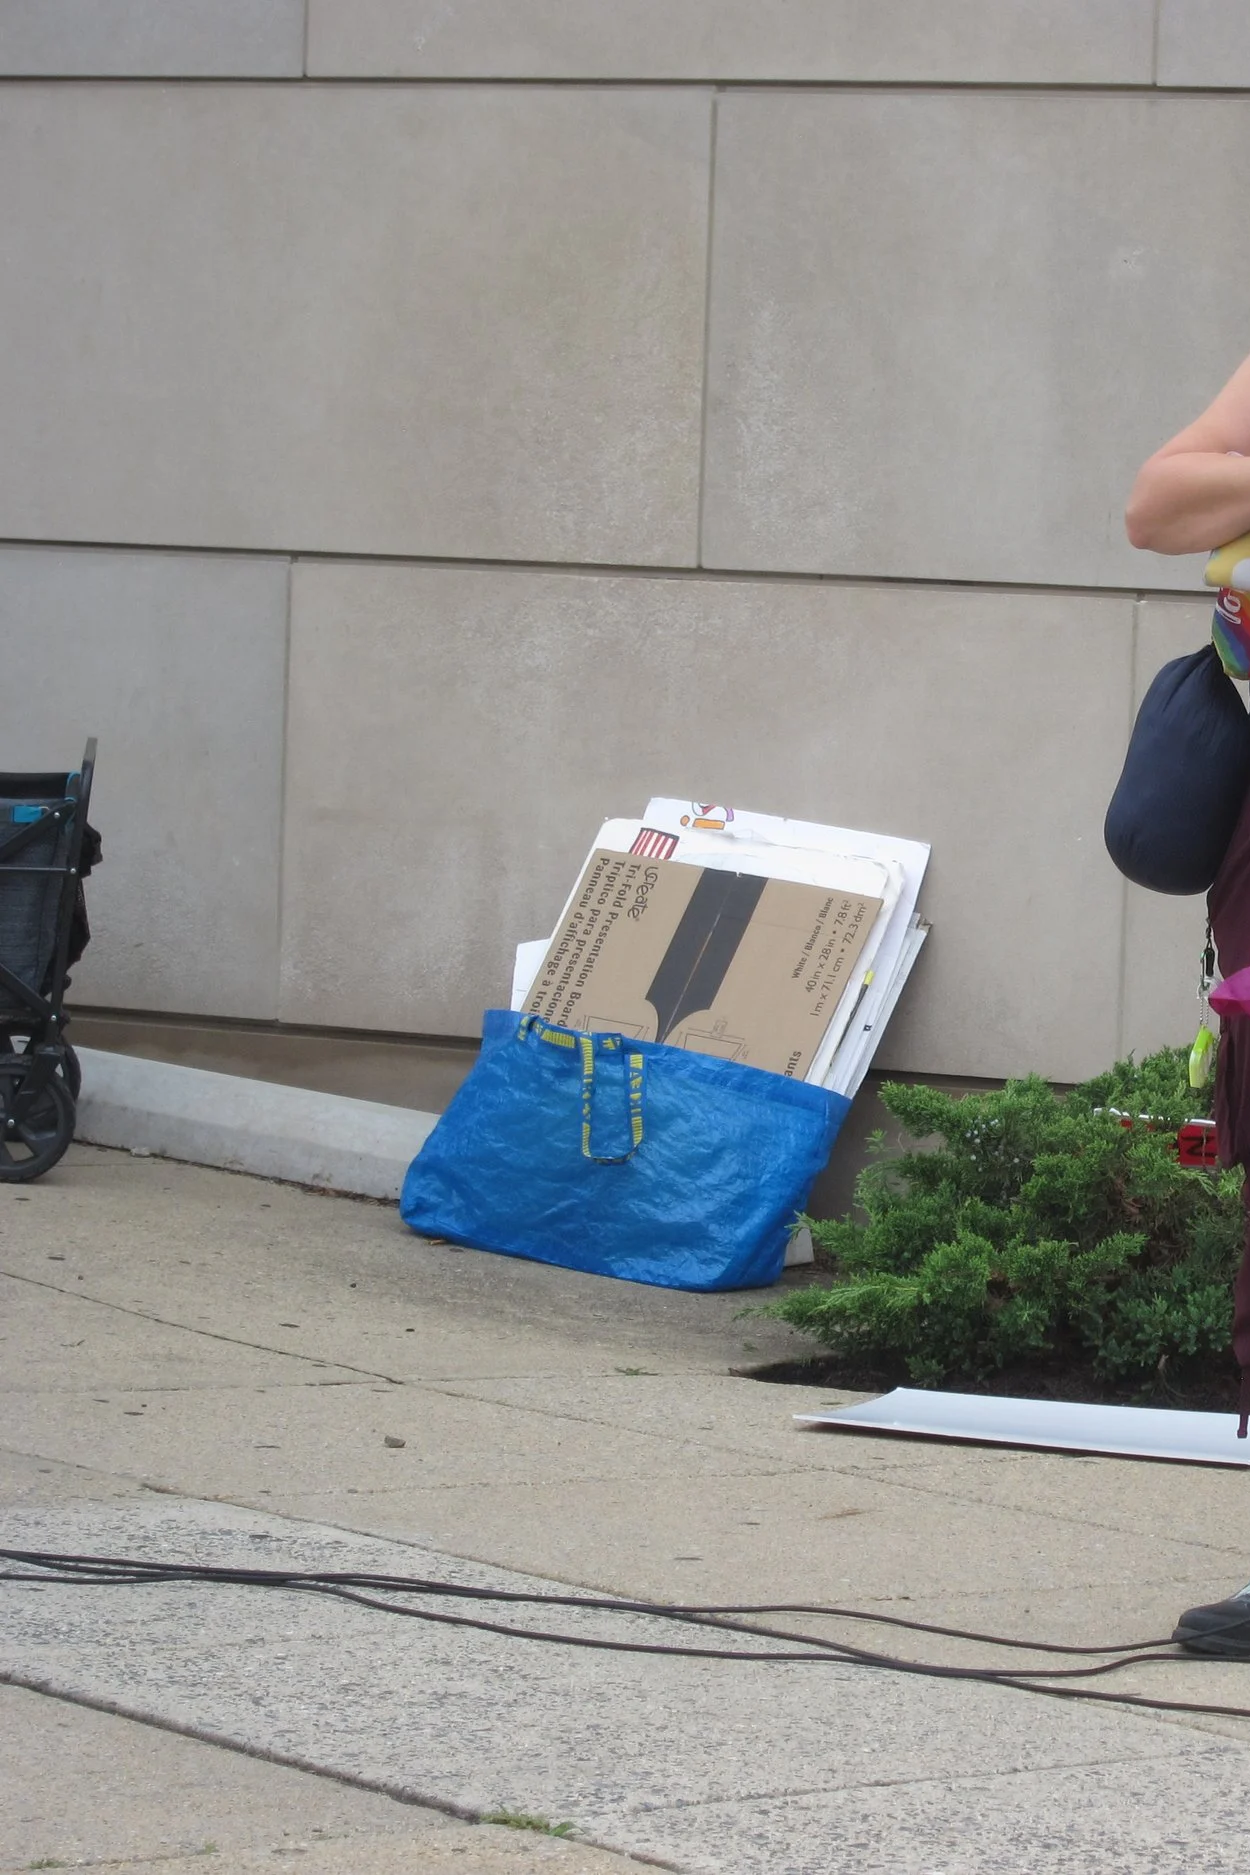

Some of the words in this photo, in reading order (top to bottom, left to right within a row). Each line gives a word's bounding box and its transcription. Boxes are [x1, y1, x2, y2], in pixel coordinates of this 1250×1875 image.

[578, 857, 611, 908] Panneau
[617, 863, 642, 909] Tri-Fold
[546, 911, 586, 977] d'affichage
[582, 907, 601, 937] para
[791, 952, 806, 980] White
[804, 924, 822, 951] Blanco
[818, 896, 834, 920] Blanc
[575, 910, 619, 988] Presentation
[556, 990, 582, 1028] Board
